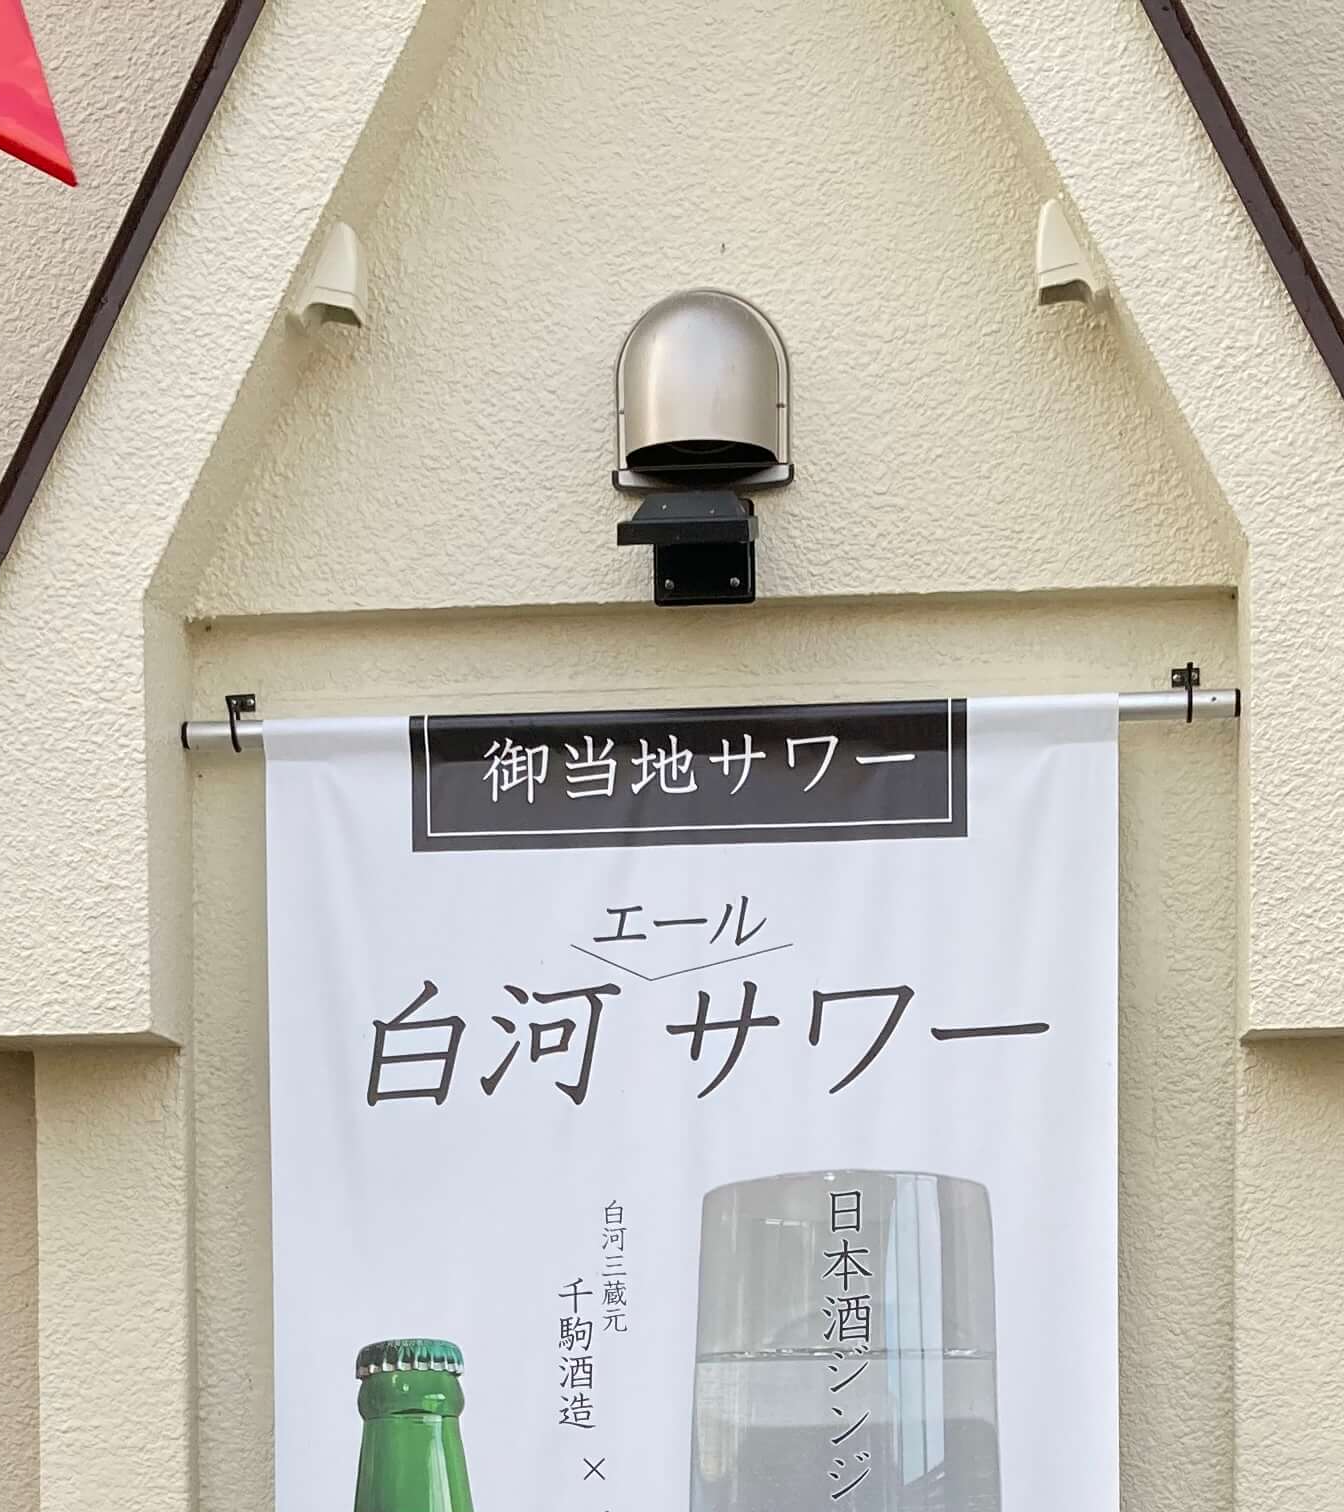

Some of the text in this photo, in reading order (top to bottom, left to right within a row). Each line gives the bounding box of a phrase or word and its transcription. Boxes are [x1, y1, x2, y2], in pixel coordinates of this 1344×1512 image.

[481, 732, 918, 806] 御当地サワー
[592, 894, 768, 947] エール
[602, 1199, 628, 1333] 白河三蔵元
[557, 1277, 596, 1430] 千駒酒造
